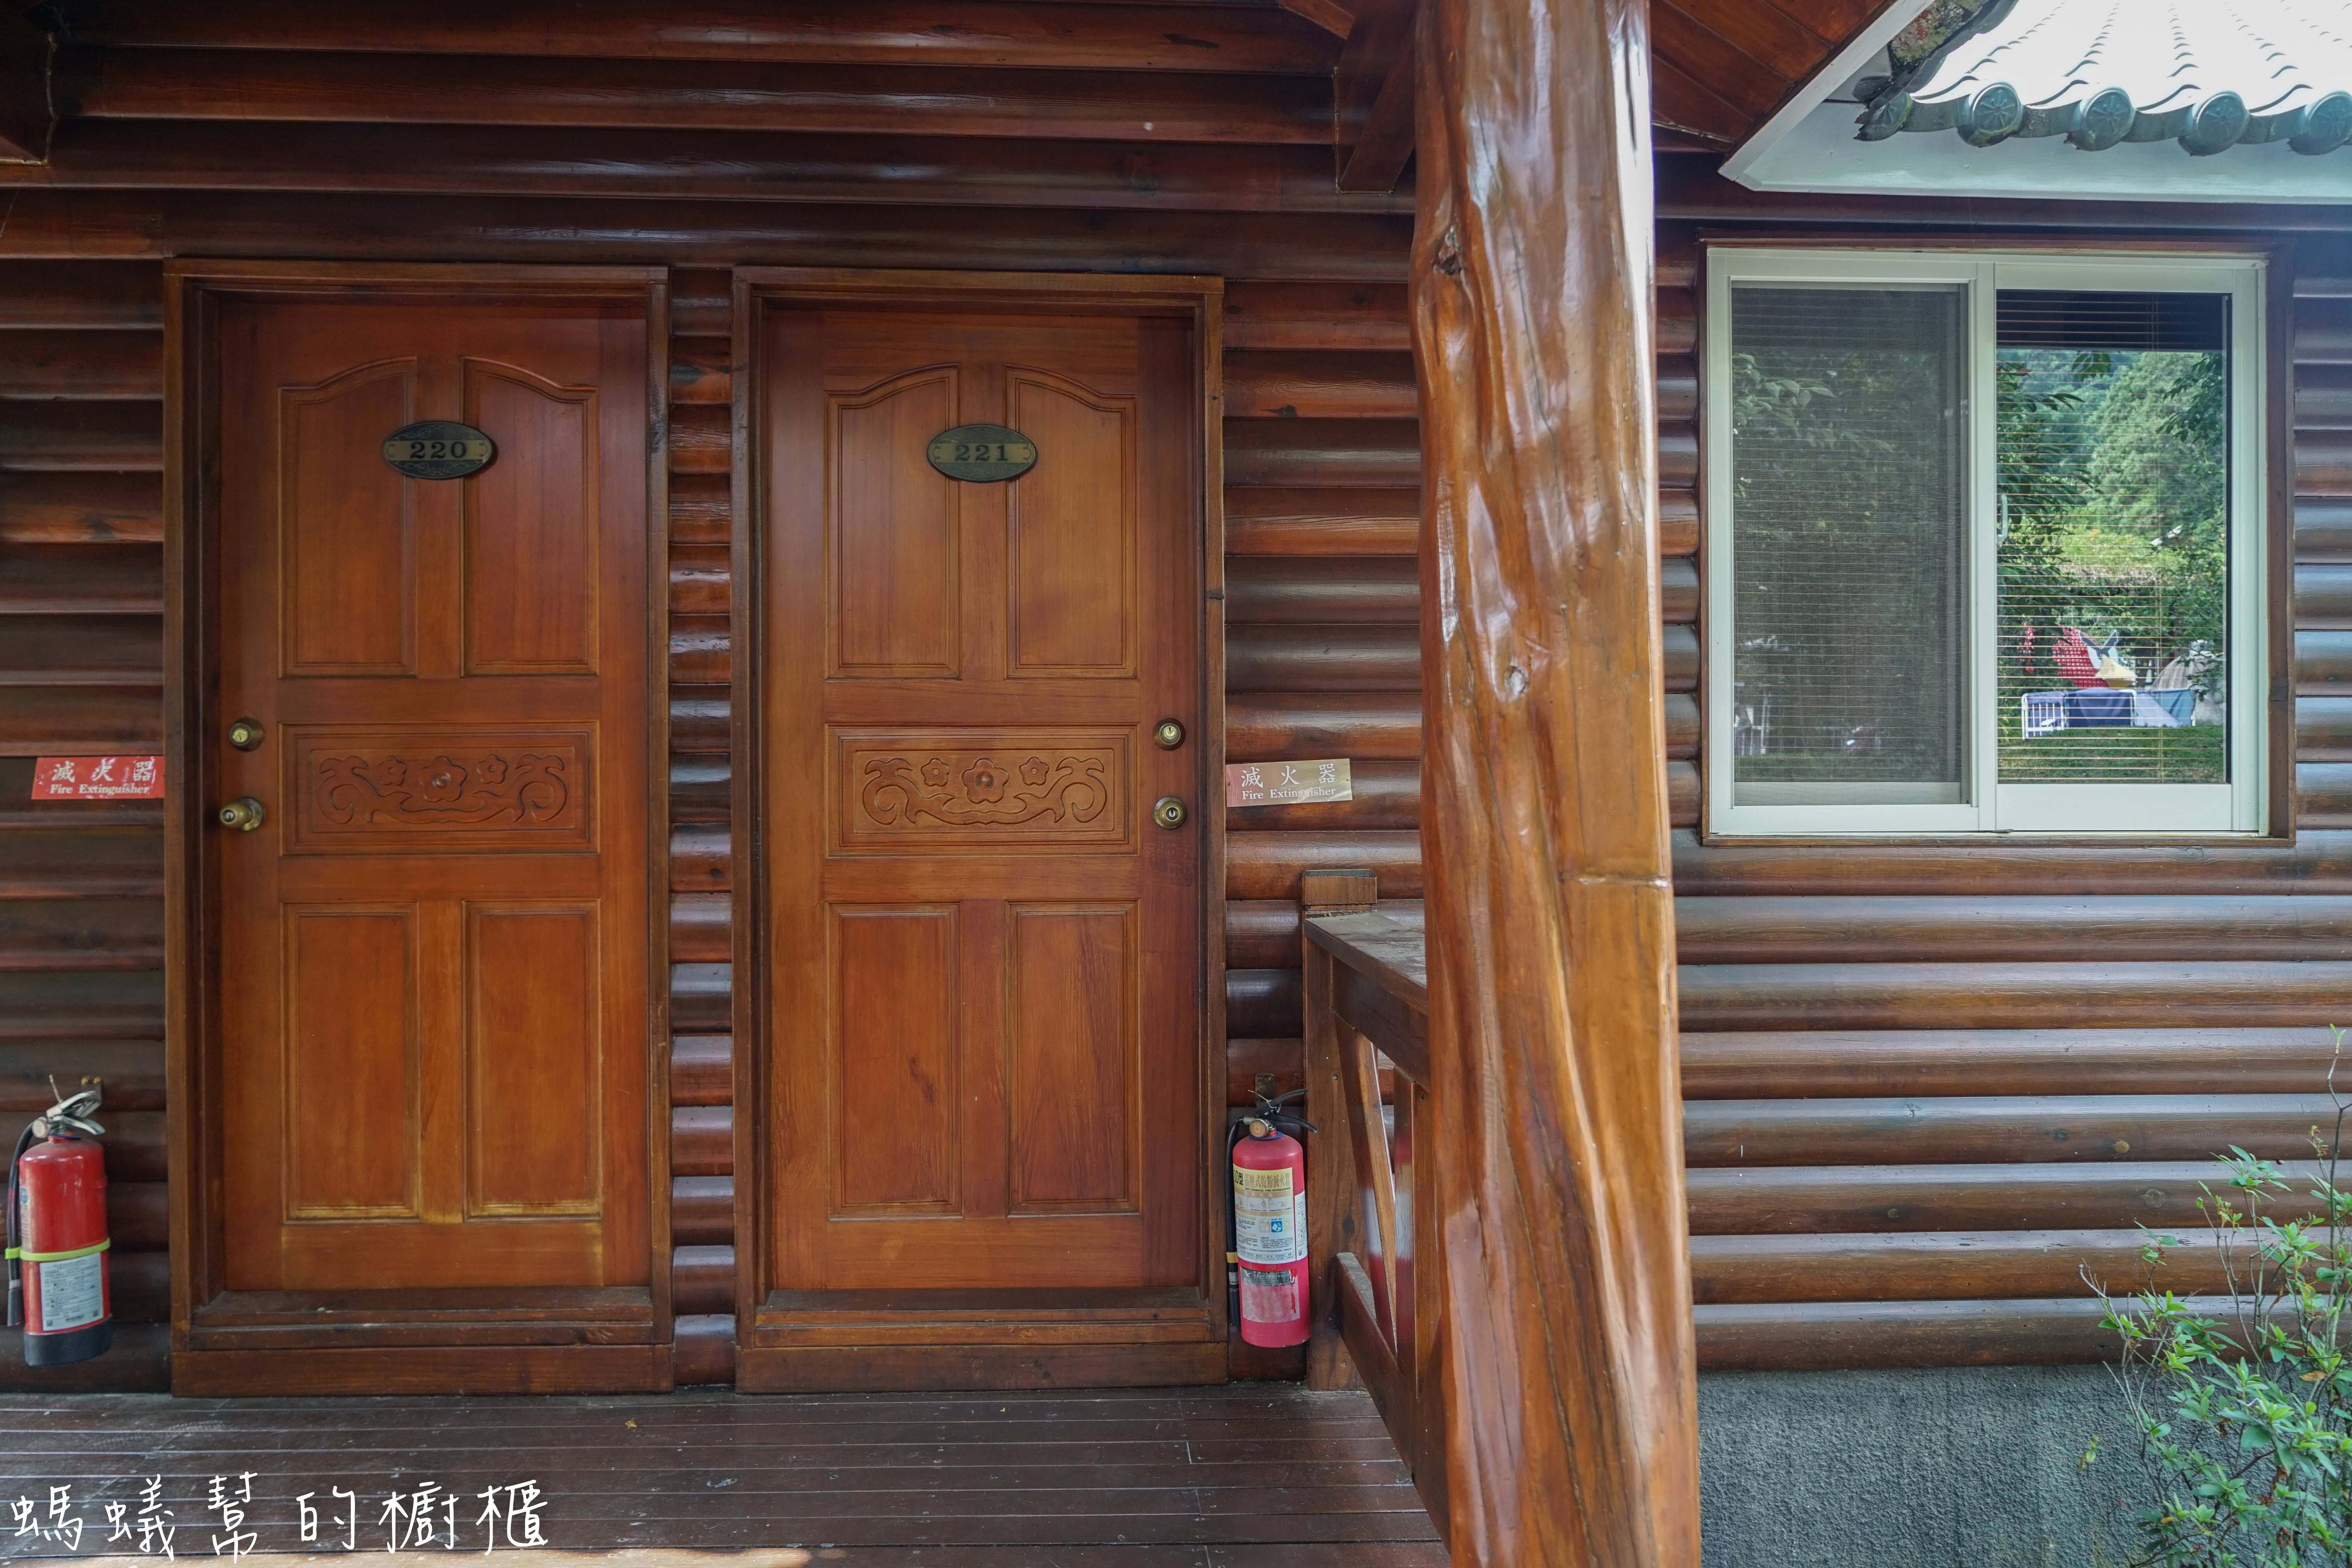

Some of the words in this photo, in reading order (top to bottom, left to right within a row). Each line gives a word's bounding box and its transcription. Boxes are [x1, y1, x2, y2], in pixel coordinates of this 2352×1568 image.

[410, 441, 467, 459] 220
[955, 445, 1008, 461] 221
[51, 759, 153, 783] 滅火器
[1241, 763, 1336, 788] 滅火器
[50, 784, 73, 794] Fire
[79, 784, 151, 795] Extinguisher
[1242, 790, 1264, 800] Fire
